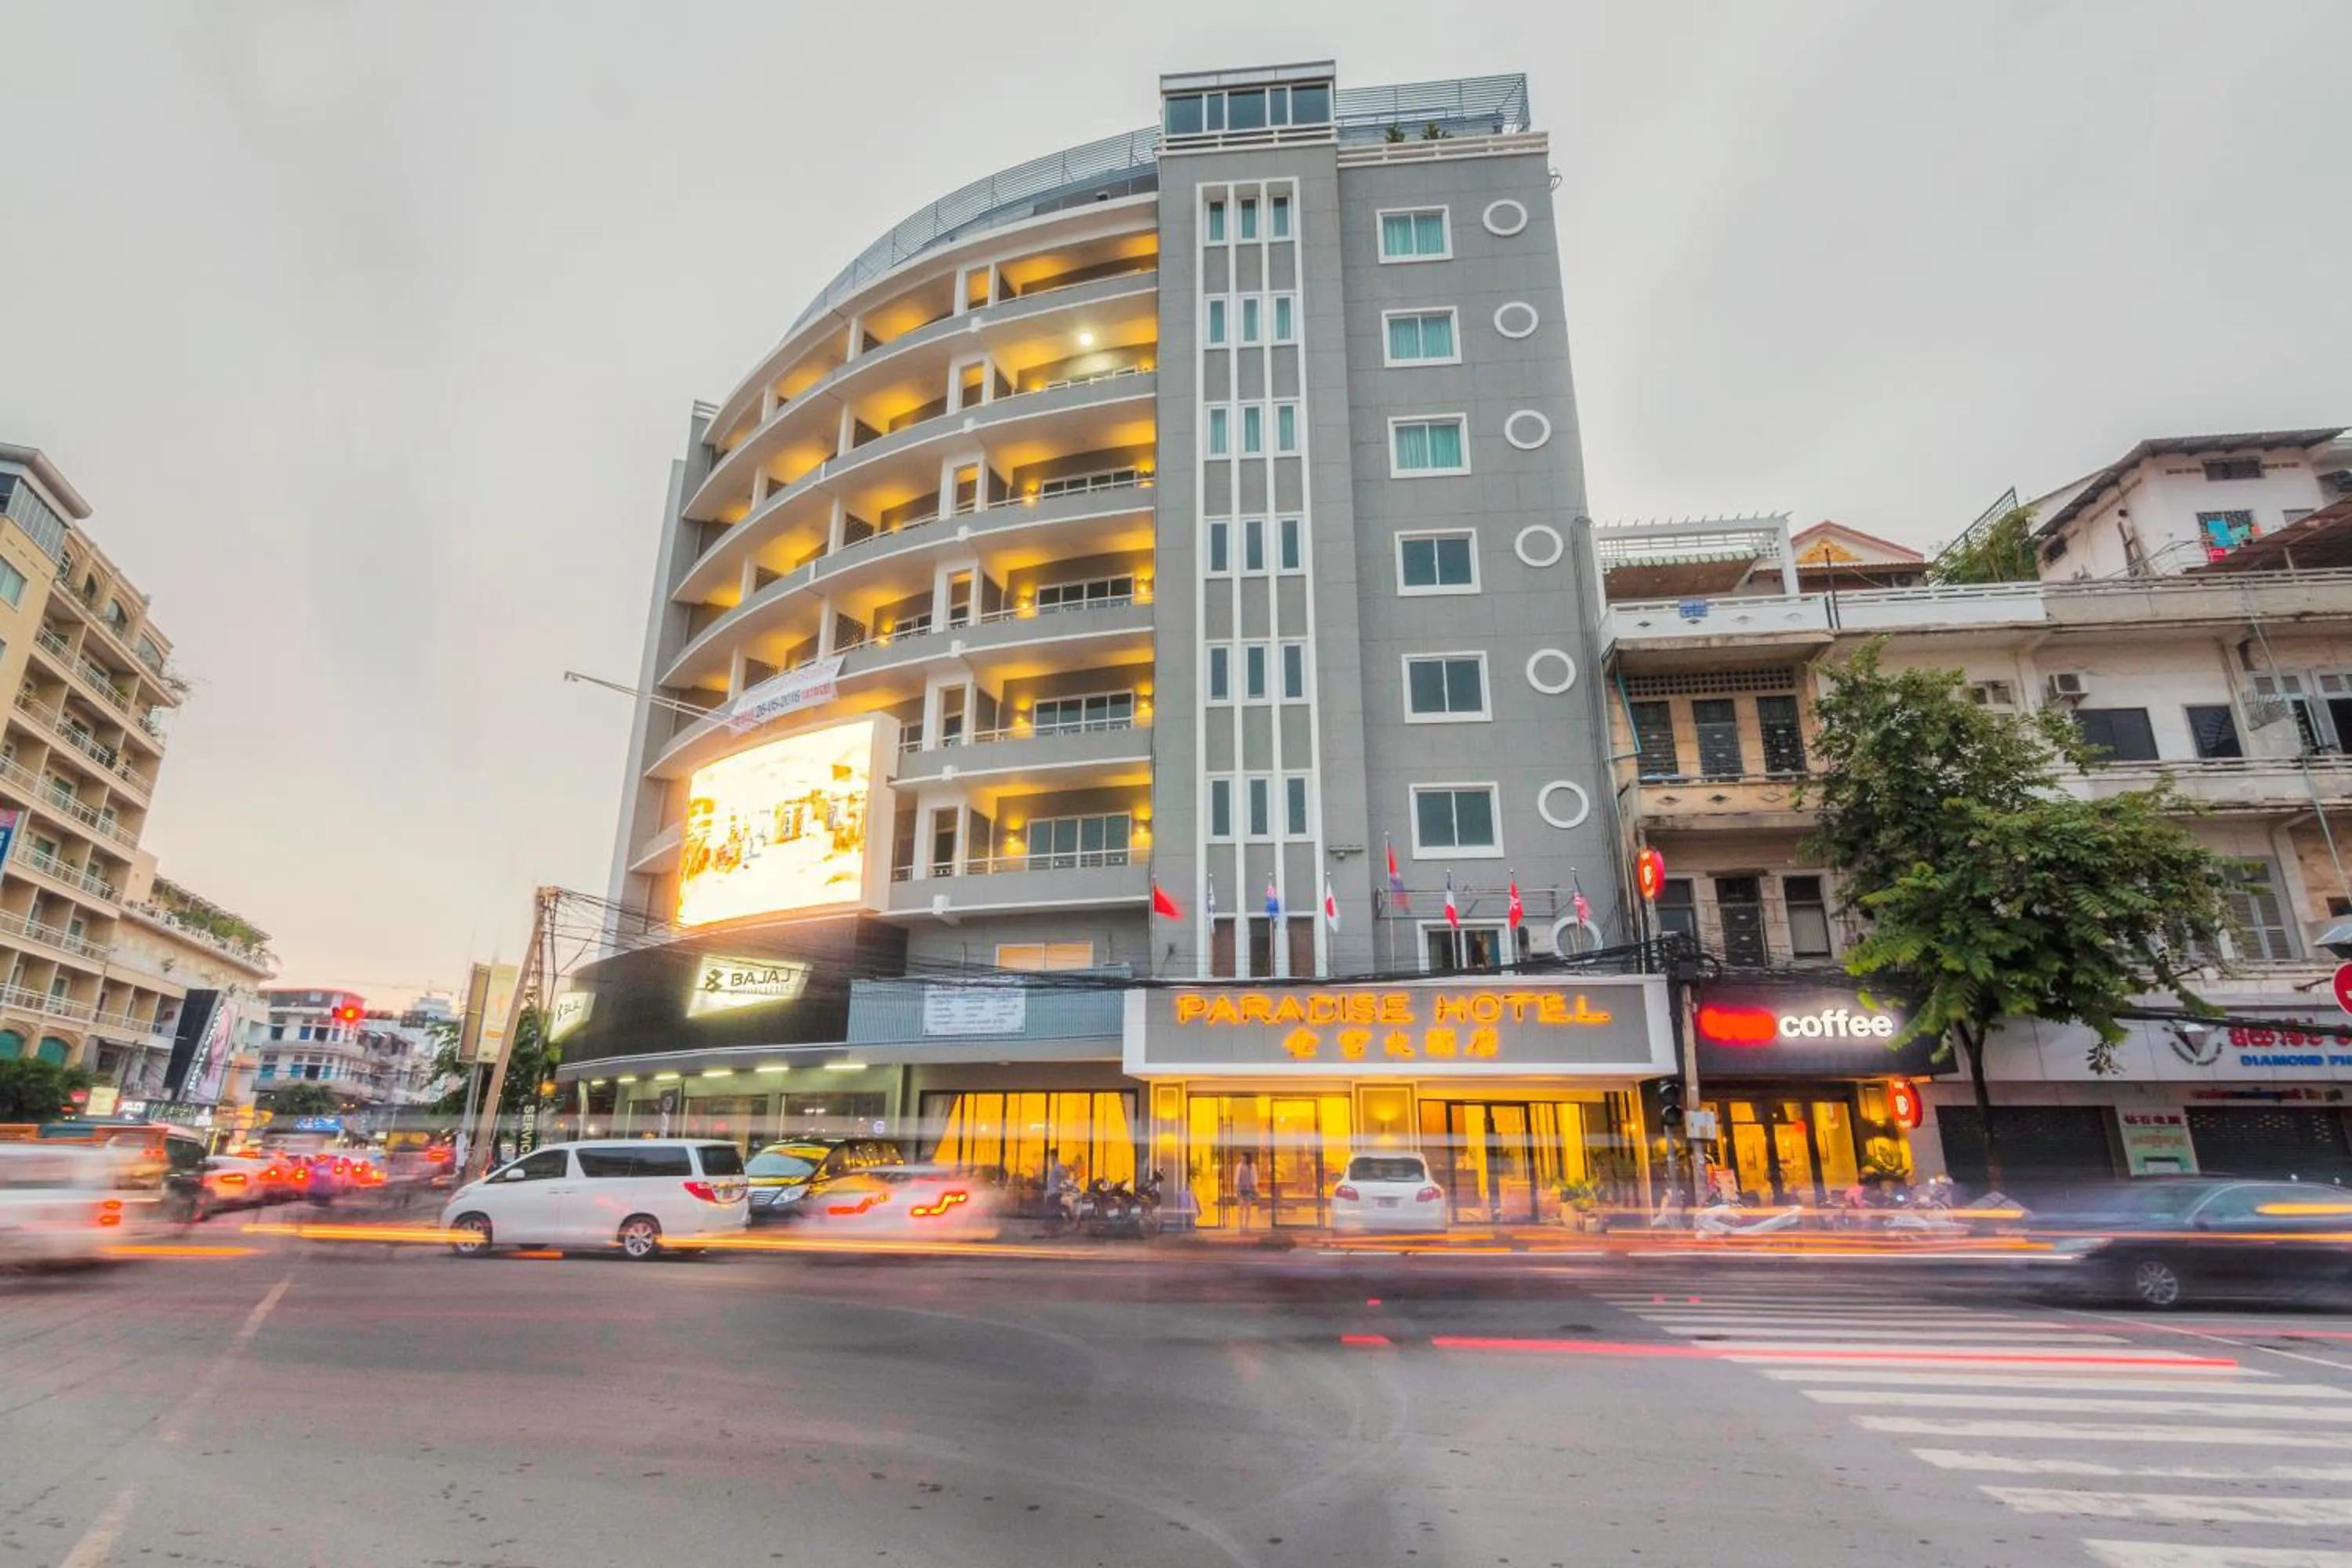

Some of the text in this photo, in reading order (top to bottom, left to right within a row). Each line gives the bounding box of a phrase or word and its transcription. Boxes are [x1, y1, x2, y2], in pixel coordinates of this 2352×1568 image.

[731, 970, 791, 986] BAJAJ
[1177, 992, 1612, 1024] PARADISE HOTEL
[1779, 1008, 1893, 1038] coffee
[2240, 1055, 2324, 1066] DIAMOND
[520, 1105, 535, 1155] SERVIC
